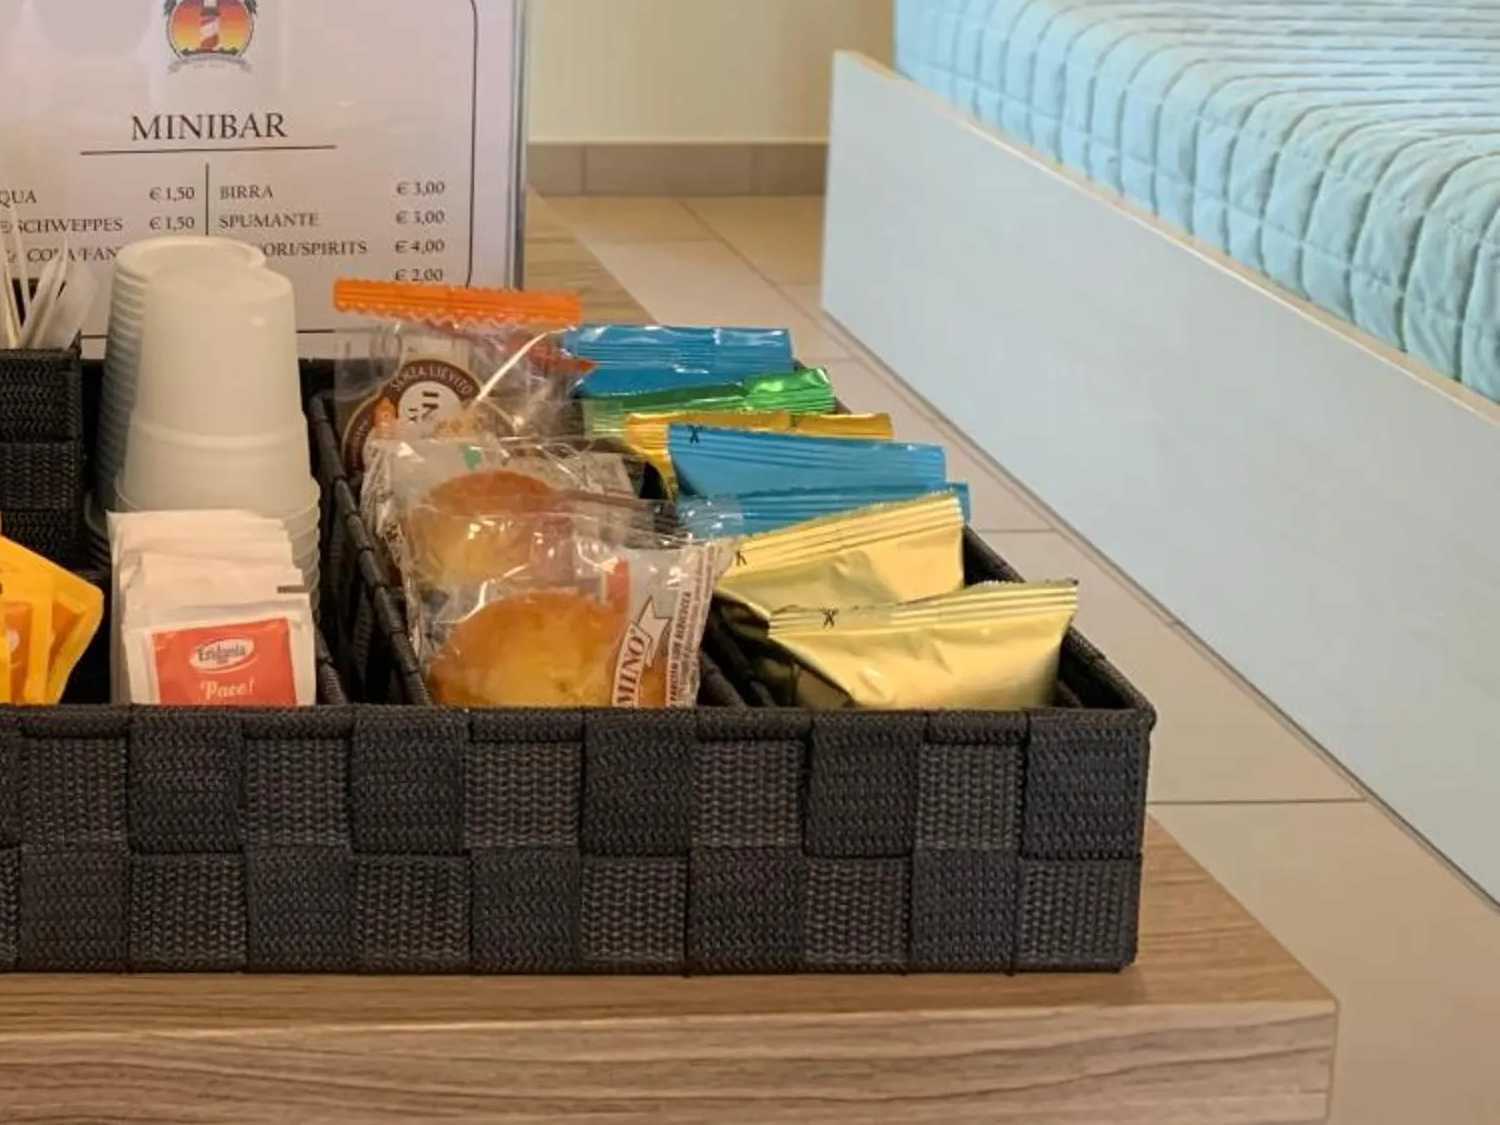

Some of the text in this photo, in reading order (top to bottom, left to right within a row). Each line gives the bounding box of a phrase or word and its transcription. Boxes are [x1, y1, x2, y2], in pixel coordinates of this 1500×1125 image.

[131, 113, 288, 141] MINIBAR
[149, 187, 162, 201] €
[166, 186, 195, 202] 1,50
[219, 184, 273, 201] BIRRA
[396, 181, 409, 195] €
[17, 218, 124, 234] SCHWEPPES
[149, 216, 162, 231] €
[166, 216, 195, 232] 1,50
[219, 212, 320, 229] SPUMANTE
[395, 211, 408, 225] €
[262, 239, 445, 257] ORI/SPIRITS € 4,00
[394, 268, 407, 282] €
